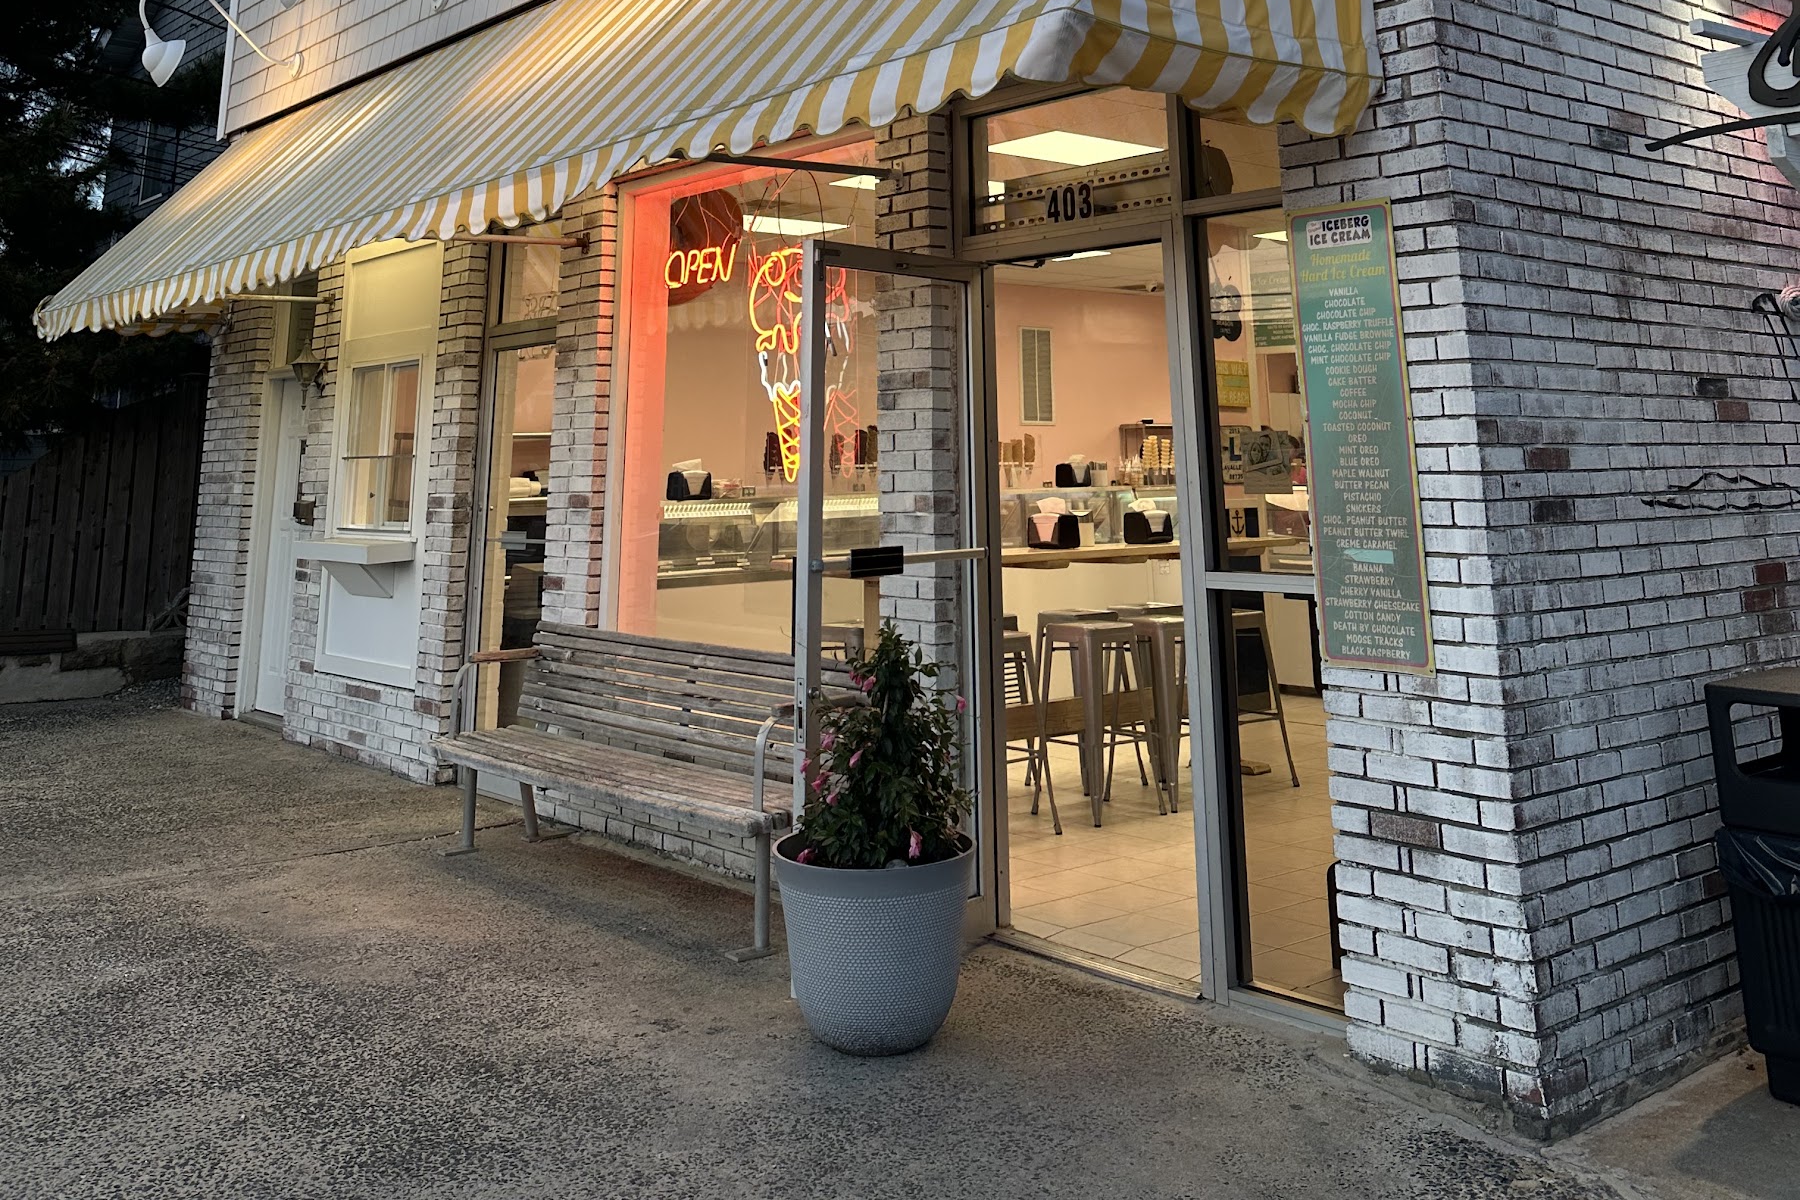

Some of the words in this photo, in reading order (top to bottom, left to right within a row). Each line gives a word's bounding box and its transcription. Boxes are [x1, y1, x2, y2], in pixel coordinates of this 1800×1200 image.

[1048, 183, 1092, 223] 403
[1322, 216, 1369, 231] ICEBERG
[1310, 233, 1327, 246] ICE
[1331, 229, 1370, 243] CREAM
[1311, 249, 1371, 266] Homemade
[665, 244, 737, 289] OPEN
[1301, 269, 1328, 282] Hard
[1330, 267, 1346, 279] Ice
[1350, 265, 1385, 278] Cream
[1329, 287, 1358, 296] VANILLA
[1325, 297, 1365, 308] CHOCOLATE
[1317, 309, 1357, 320] CHOCOLATE
[1359, 308, 1376, 317] CHIP
[1302, 323, 1321, 332] CHOC.
[1323, 320, 1361, 330] RASPBERRY
[1364, 317, 1394, 328] TRUFFLE
[1304, 333, 1332, 342] VANILLA
[1335, 331, 1357, 341] FUDGE
[1360, 329, 1394, 339] BROWNIE
[1308, 345, 1328, 354] CHOC.
[1331, 342, 1372, 352] CHOCOLATE
[1375, 341, 1391, 349] CHIP
[1311, 355, 1328, 365] MINT
[1331, 353, 1372, 363] CHOCOLATE
[1375, 352, 1391, 360] CHIP
[1326, 365, 1350, 375] COOKIE
[1353, 364, 1377, 373] DOUGH
[1328, 377, 1346, 386] CAKE
[1349, 376, 1377, 385] BATTER
[1340, 388, 1367, 397] COFFEE
[1332, 400, 1358, 408] MOCHA
[1360, 399, 1377, 407] CHIP
[1339, 410, 1372, 420] COCONUT
[1323, 423, 1355, 432] TOASTED
[1357, 422, 1391, 431] COCONUT
[1348, 434, 1367, 442] OREO
[1339, 445, 1357, 454] MINT
[1360, 446, 1379, 454] OREO
[1340, 457, 1358, 466] BLUE
[1360, 457, 1380, 466] OREO
[1332, 469, 1356, 478] MAPLE
[1358, 469, 1390, 478] WALNUT
[1335, 480, 1362, 489] BUTTER
[1365, 480, 1389, 490] PECAN
[1344, 492, 1382, 501] PISTACHIO
[1346, 504, 1381, 513] SNICKERS
[1323, 515, 1344, 525] CHOC.
[1347, 516, 1376, 525] PEANUT
[1378, 517, 1407, 525] BUTTER
[1324, 527, 1352, 536] PEANUT
[1354, 528, 1383, 537] BUTTER
[1386, 529, 1409, 538] TWIRL
[1337, 539, 1361, 548] CREME
[1363, 540, 1397, 550] CARAMEL
[1353, 563, 1383, 573] BANANA
[1345, 575, 1394, 586] STRAWBERRY
[1340, 586, 1368, 596] CHERRY
[1370, 587, 1401, 599] VANILLA
[1325, 597, 1372, 609] STRAWBERRY
[1374, 600, 1420, 612] CHEESECAKE
[1345, 610, 1374, 621] COTTON
[1377, 612, 1401, 622] CANDY
[1333, 621, 1357, 631] DEATH
[1360, 623, 1369, 632] BY
[1372, 624, 1415, 636] CHOCOLATE
[1346, 634, 1372, 644] MOOSE
[1375, 636, 1403, 647] TRACKS
[1342, 645, 1365, 655] BLACK
[1367, 647, 1410, 660] RASPBERRY
